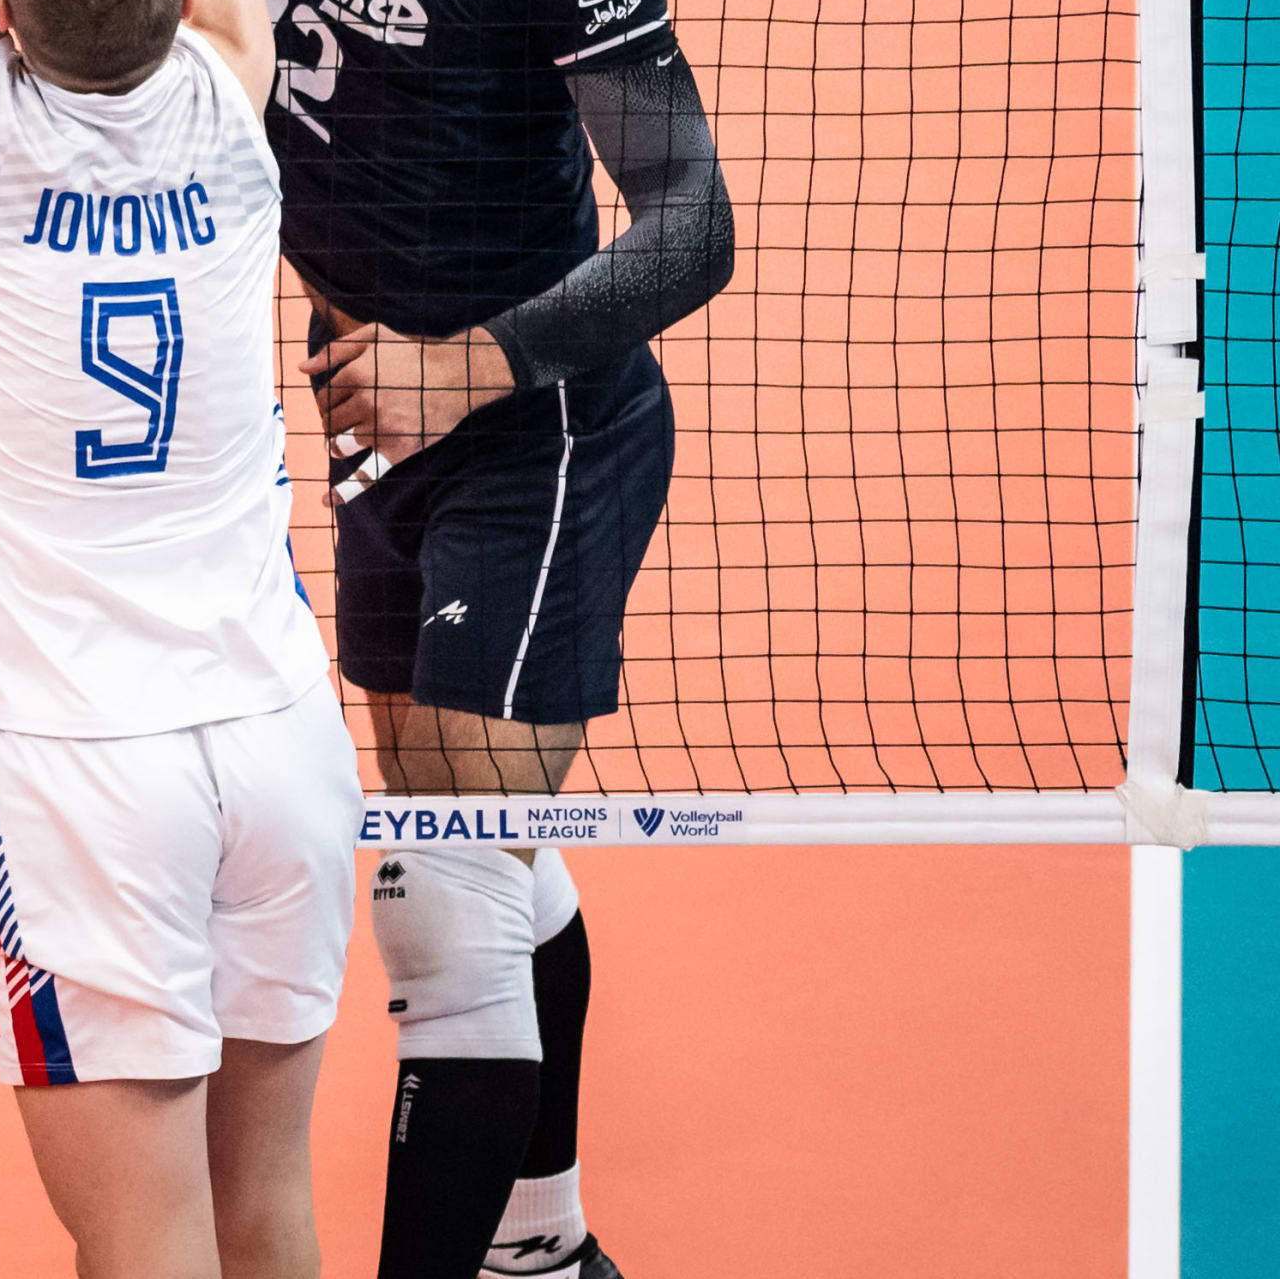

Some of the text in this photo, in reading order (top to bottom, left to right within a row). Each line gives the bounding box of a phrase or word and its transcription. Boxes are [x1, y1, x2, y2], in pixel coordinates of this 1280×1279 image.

[23, 170, 216, 257] JOVOVIĆ
[75, 277, 184, 479] 9
[527, 808, 608, 821] NATIONS
[670, 810, 743, 824] Volleyball
[360, 809, 519, 840] EYBALL
[670, 823, 719, 837] World
[528, 825, 598, 839] LEAGUE
